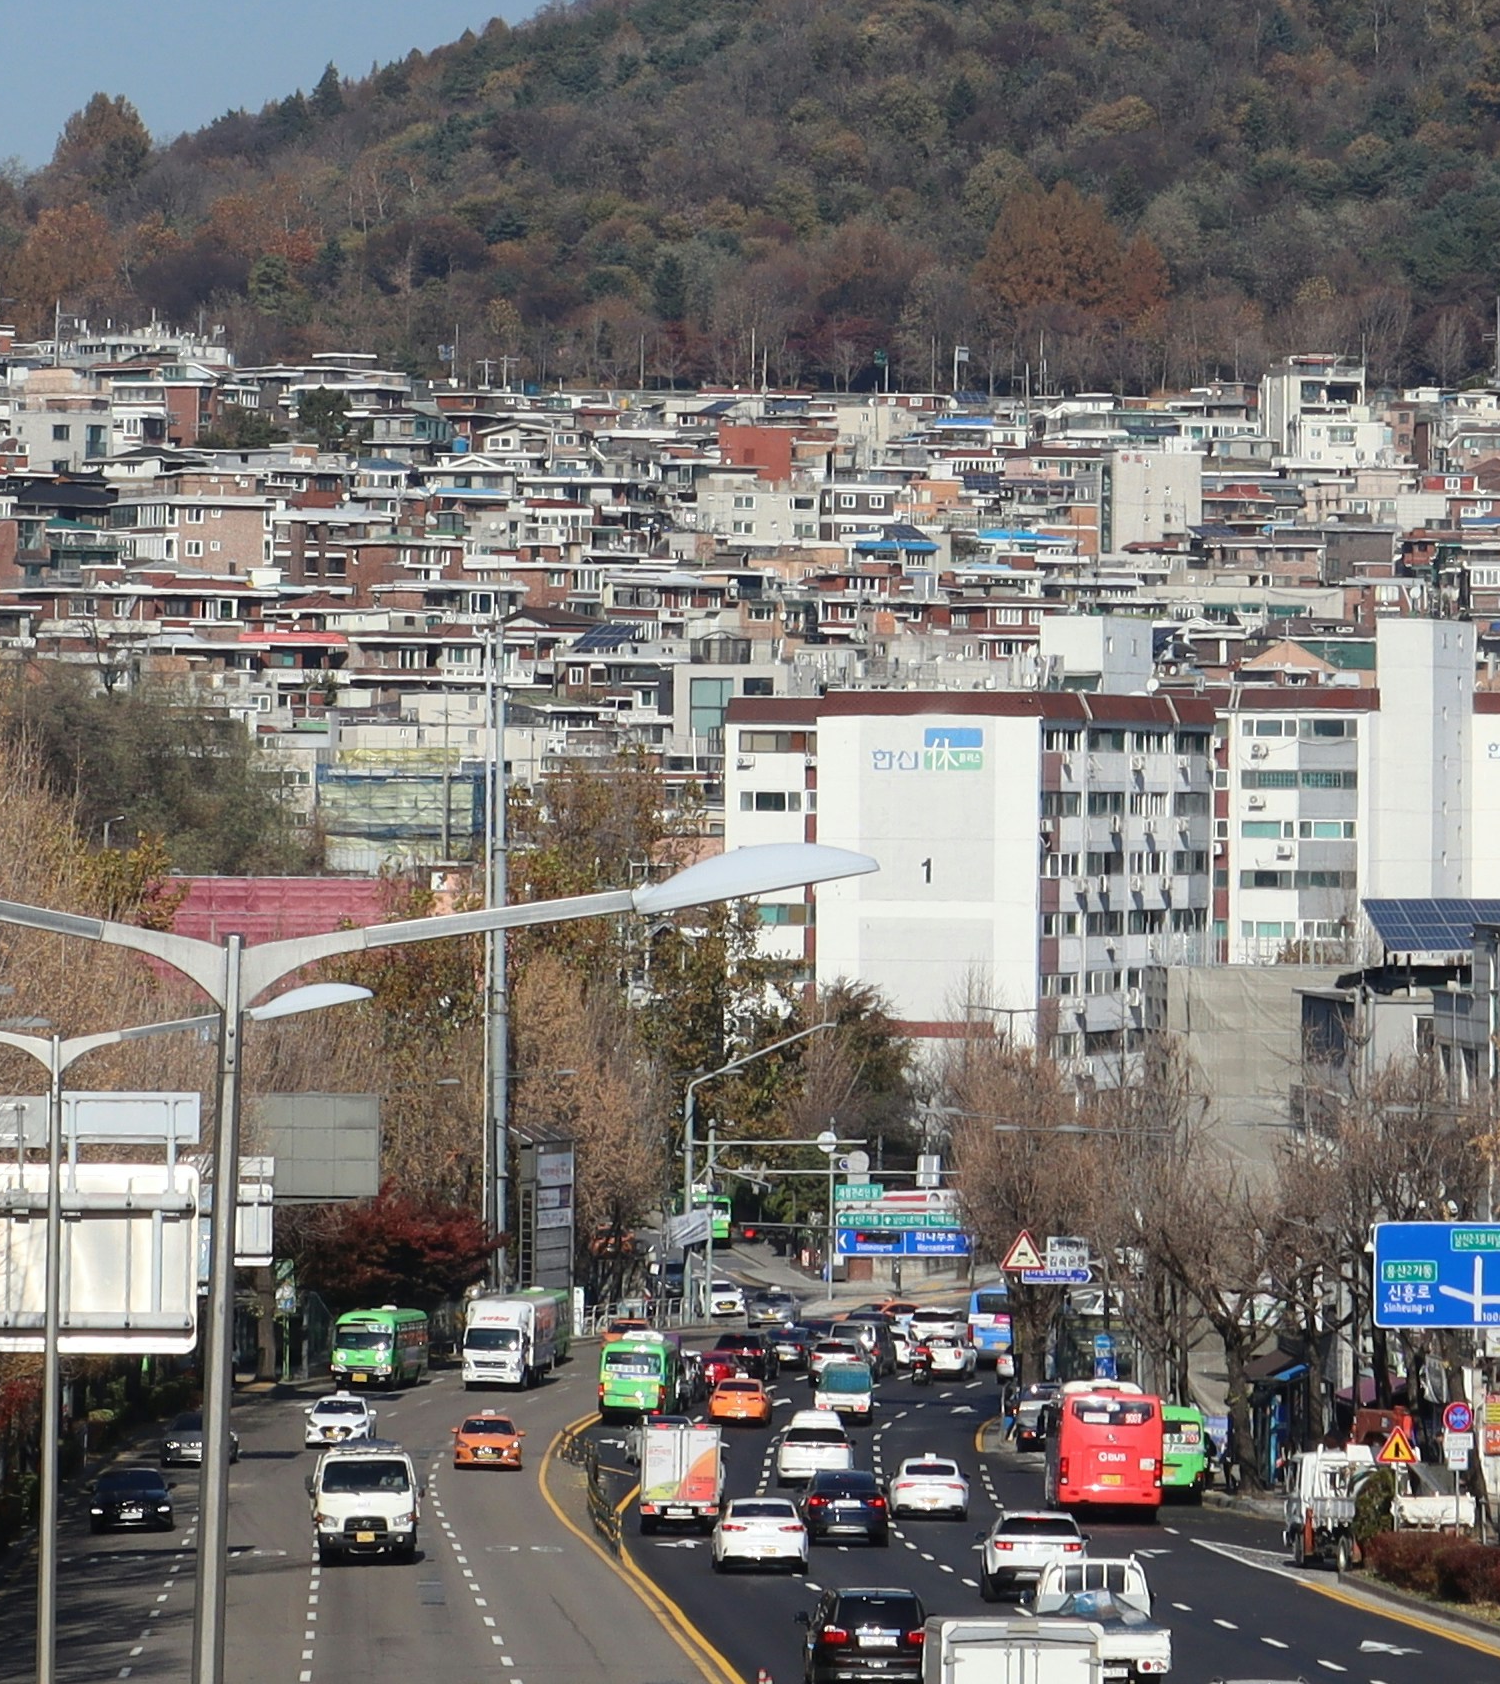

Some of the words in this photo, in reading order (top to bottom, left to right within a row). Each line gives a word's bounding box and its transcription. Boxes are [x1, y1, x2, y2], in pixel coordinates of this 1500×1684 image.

[872, 749, 919, 771] 한신
[927, 737, 960, 772] 休
[921, 857, 932, 884] 1
[1386, 1264, 1433, 1279] 용산2가동
[1388, 1284, 1432, 1303] 신흥로
